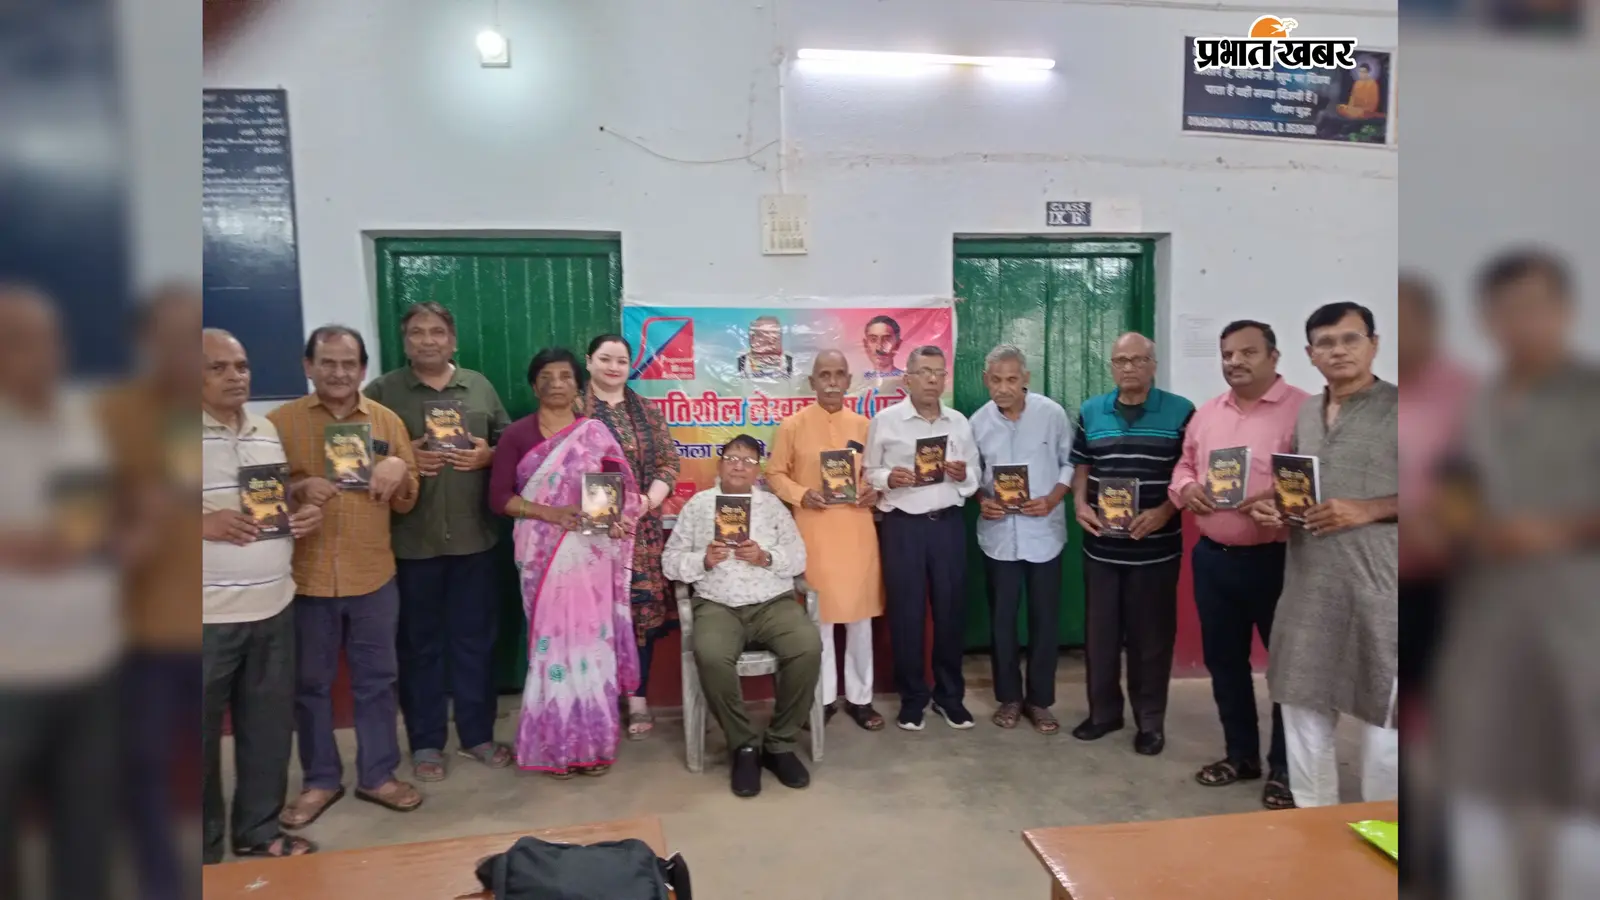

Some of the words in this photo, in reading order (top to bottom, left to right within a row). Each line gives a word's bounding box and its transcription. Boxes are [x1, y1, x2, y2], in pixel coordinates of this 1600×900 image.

[1050, 202, 1087, 212] CLASS
[1049, 211, 1069, 225] IX
[650, 389, 743, 424] गतिशील
